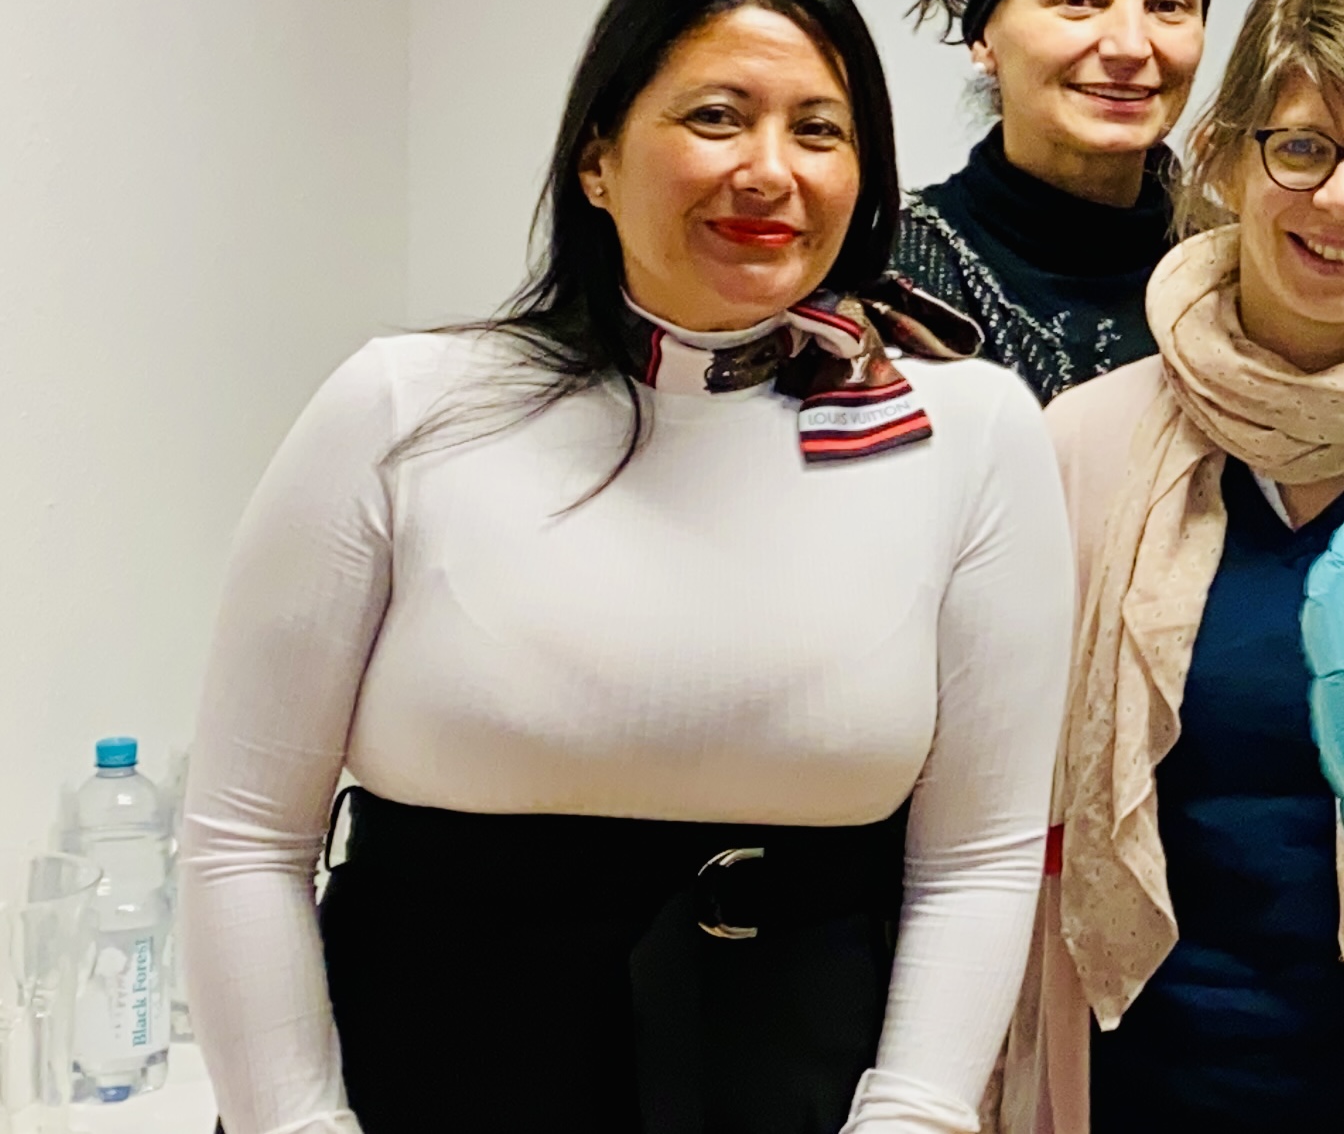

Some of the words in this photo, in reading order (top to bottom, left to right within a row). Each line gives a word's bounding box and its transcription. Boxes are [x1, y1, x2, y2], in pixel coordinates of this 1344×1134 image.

[808, 412, 848, 426] LOUIS
[849, 400, 912, 425] VUITTON
[132, 939, 147, 993] Forest
[132, 997, 147, 1047] Black
